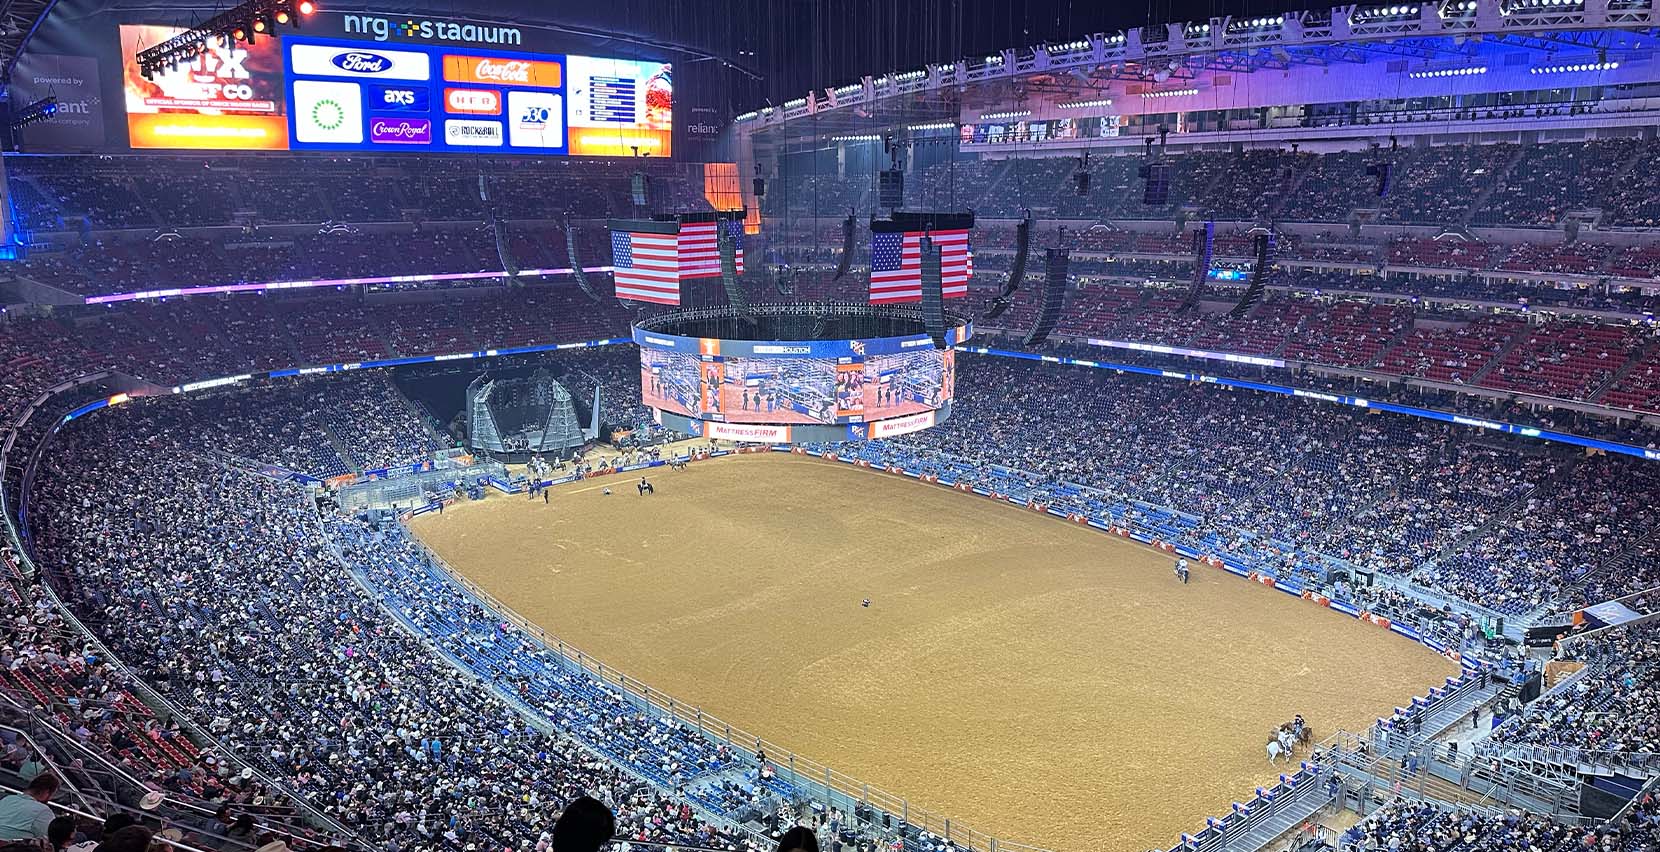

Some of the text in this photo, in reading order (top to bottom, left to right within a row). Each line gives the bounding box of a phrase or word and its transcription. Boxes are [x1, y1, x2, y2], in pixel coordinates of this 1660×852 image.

[344, 14, 389, 41] nrg
[342, 52, 382, 72] Ford
[33, 76, 84, 87] powered by
[373, 122, 427, 138] Crown Royal
